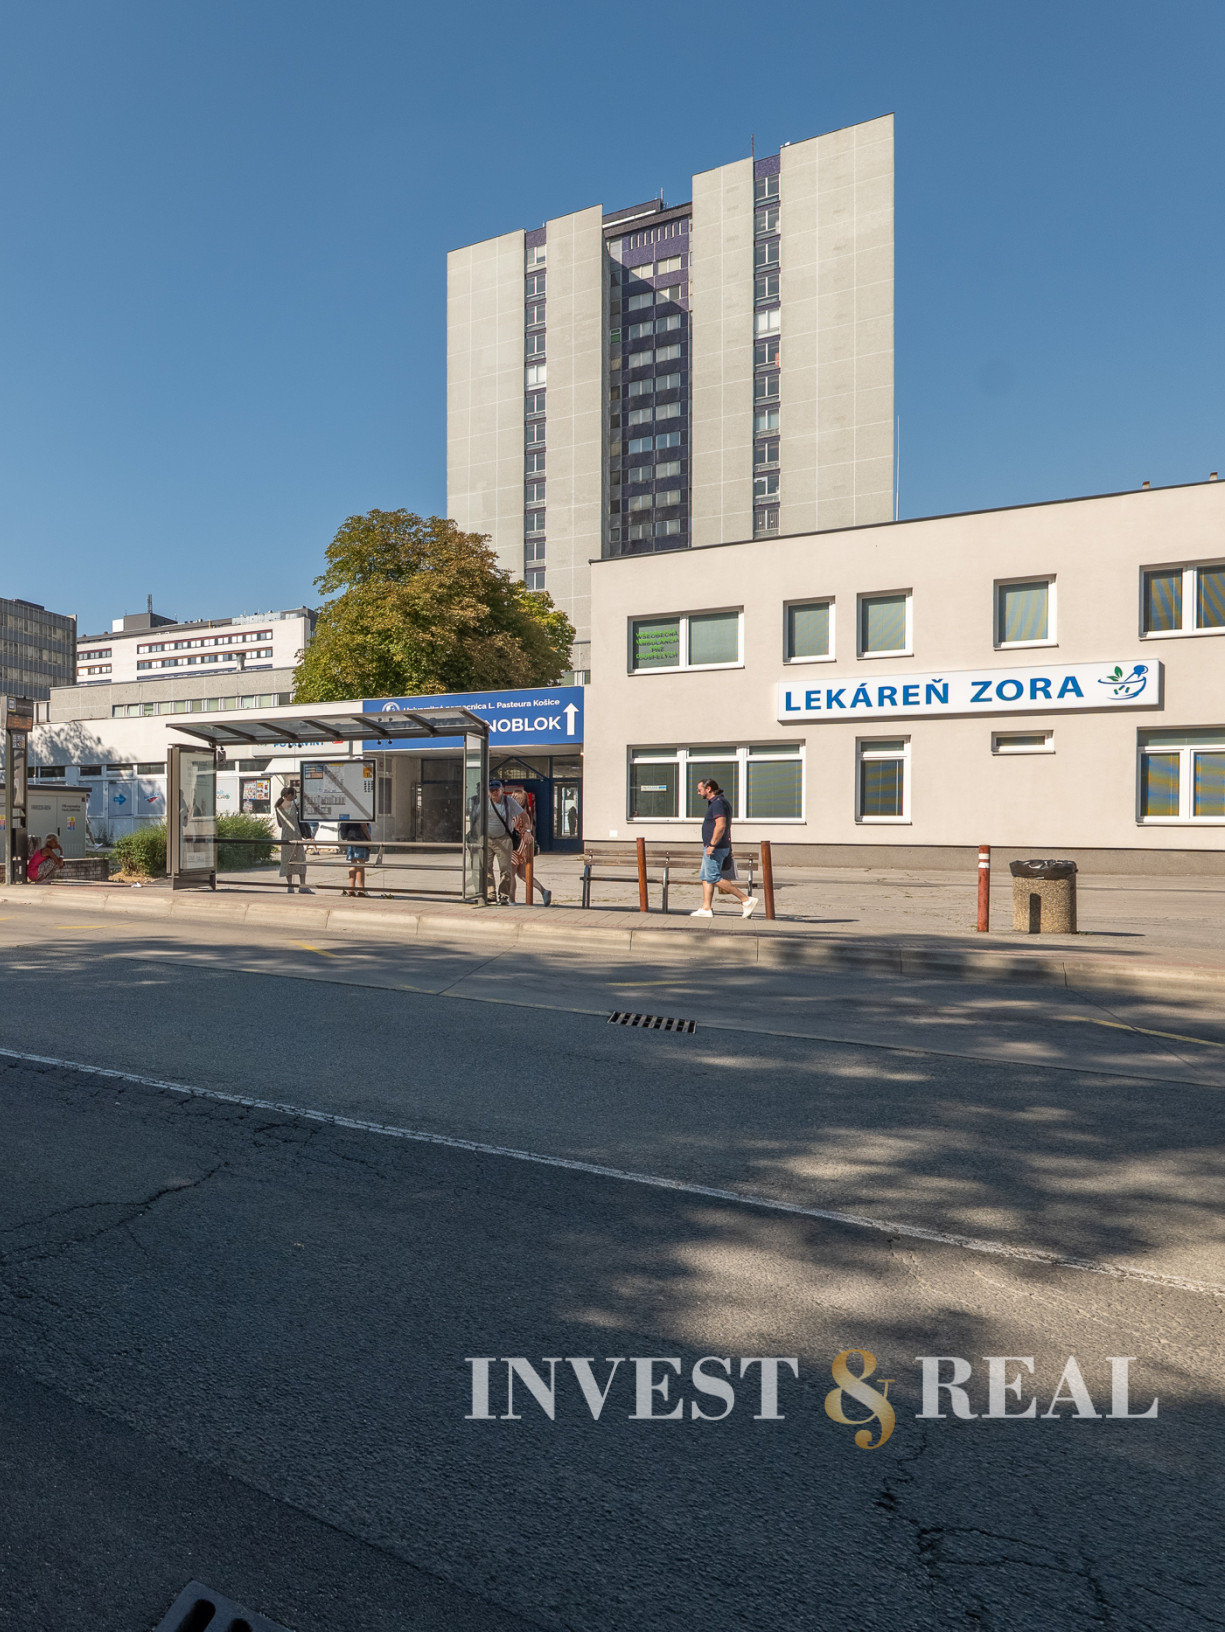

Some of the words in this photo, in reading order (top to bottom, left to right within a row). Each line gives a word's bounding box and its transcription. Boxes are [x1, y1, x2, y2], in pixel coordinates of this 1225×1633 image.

[785, 678, 949, 712] LEKÁREŇ
[970, 675, 1084, 703] ZORA
[533, 699, 560, 707] Košice
[485, 716, 561, 733] NOBLOK
